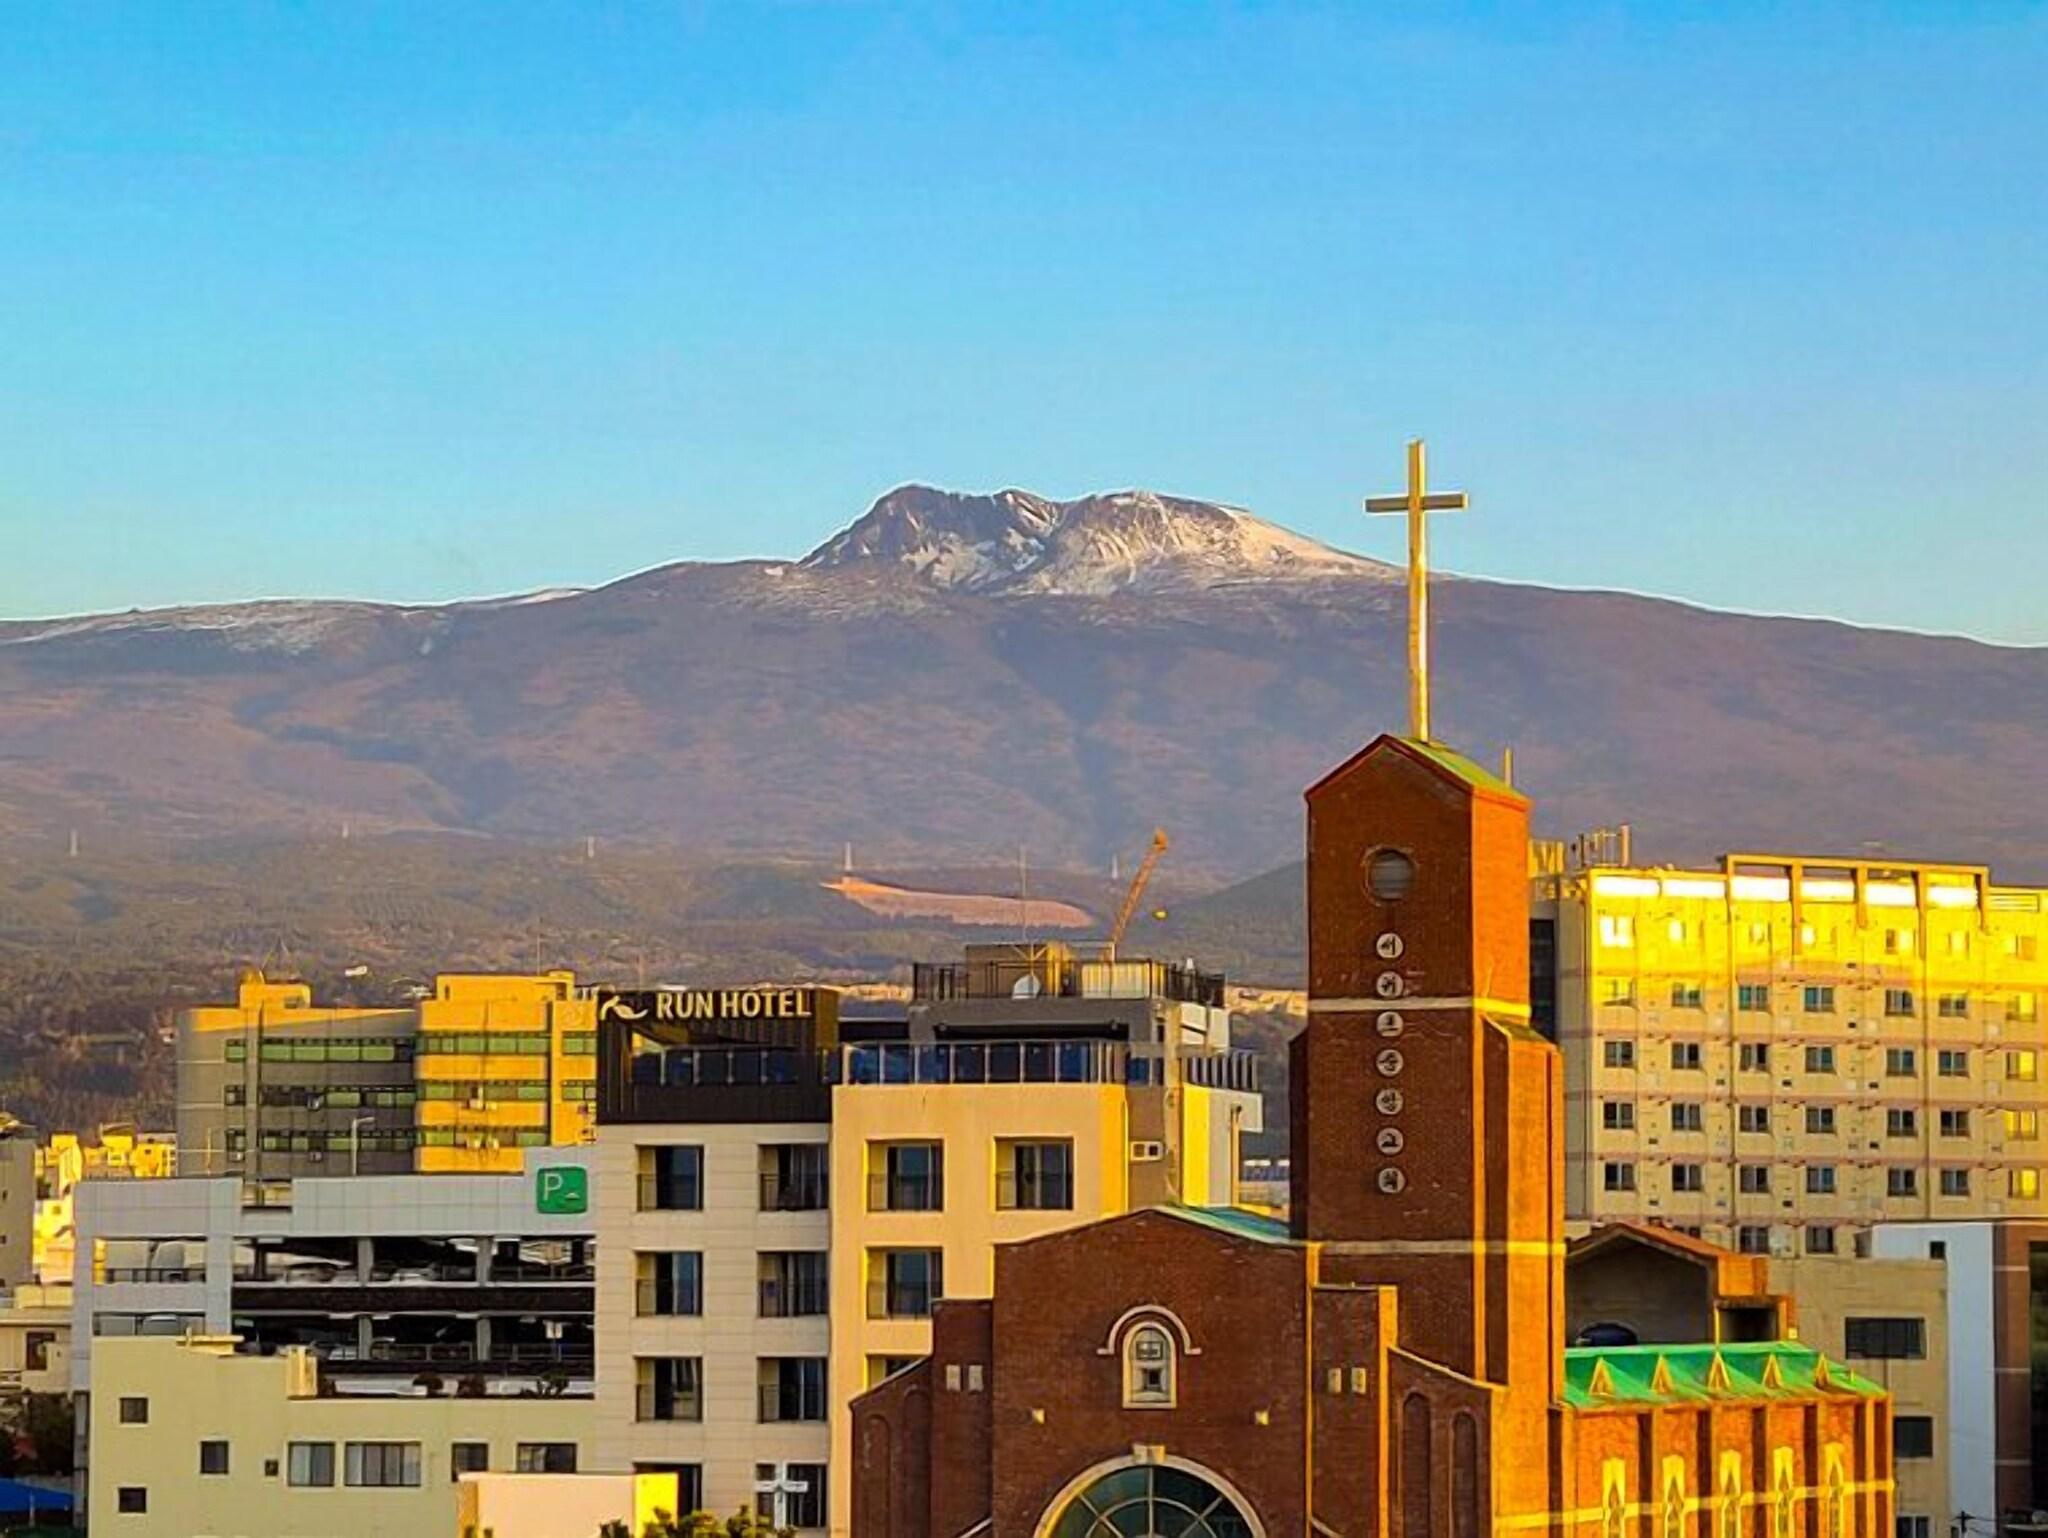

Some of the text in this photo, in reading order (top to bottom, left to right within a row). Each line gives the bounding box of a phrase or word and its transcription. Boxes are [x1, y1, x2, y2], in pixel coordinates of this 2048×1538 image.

[656, 990, 812, 1019] RUN HOTEL
[543, 1172, 563, 1201] P
